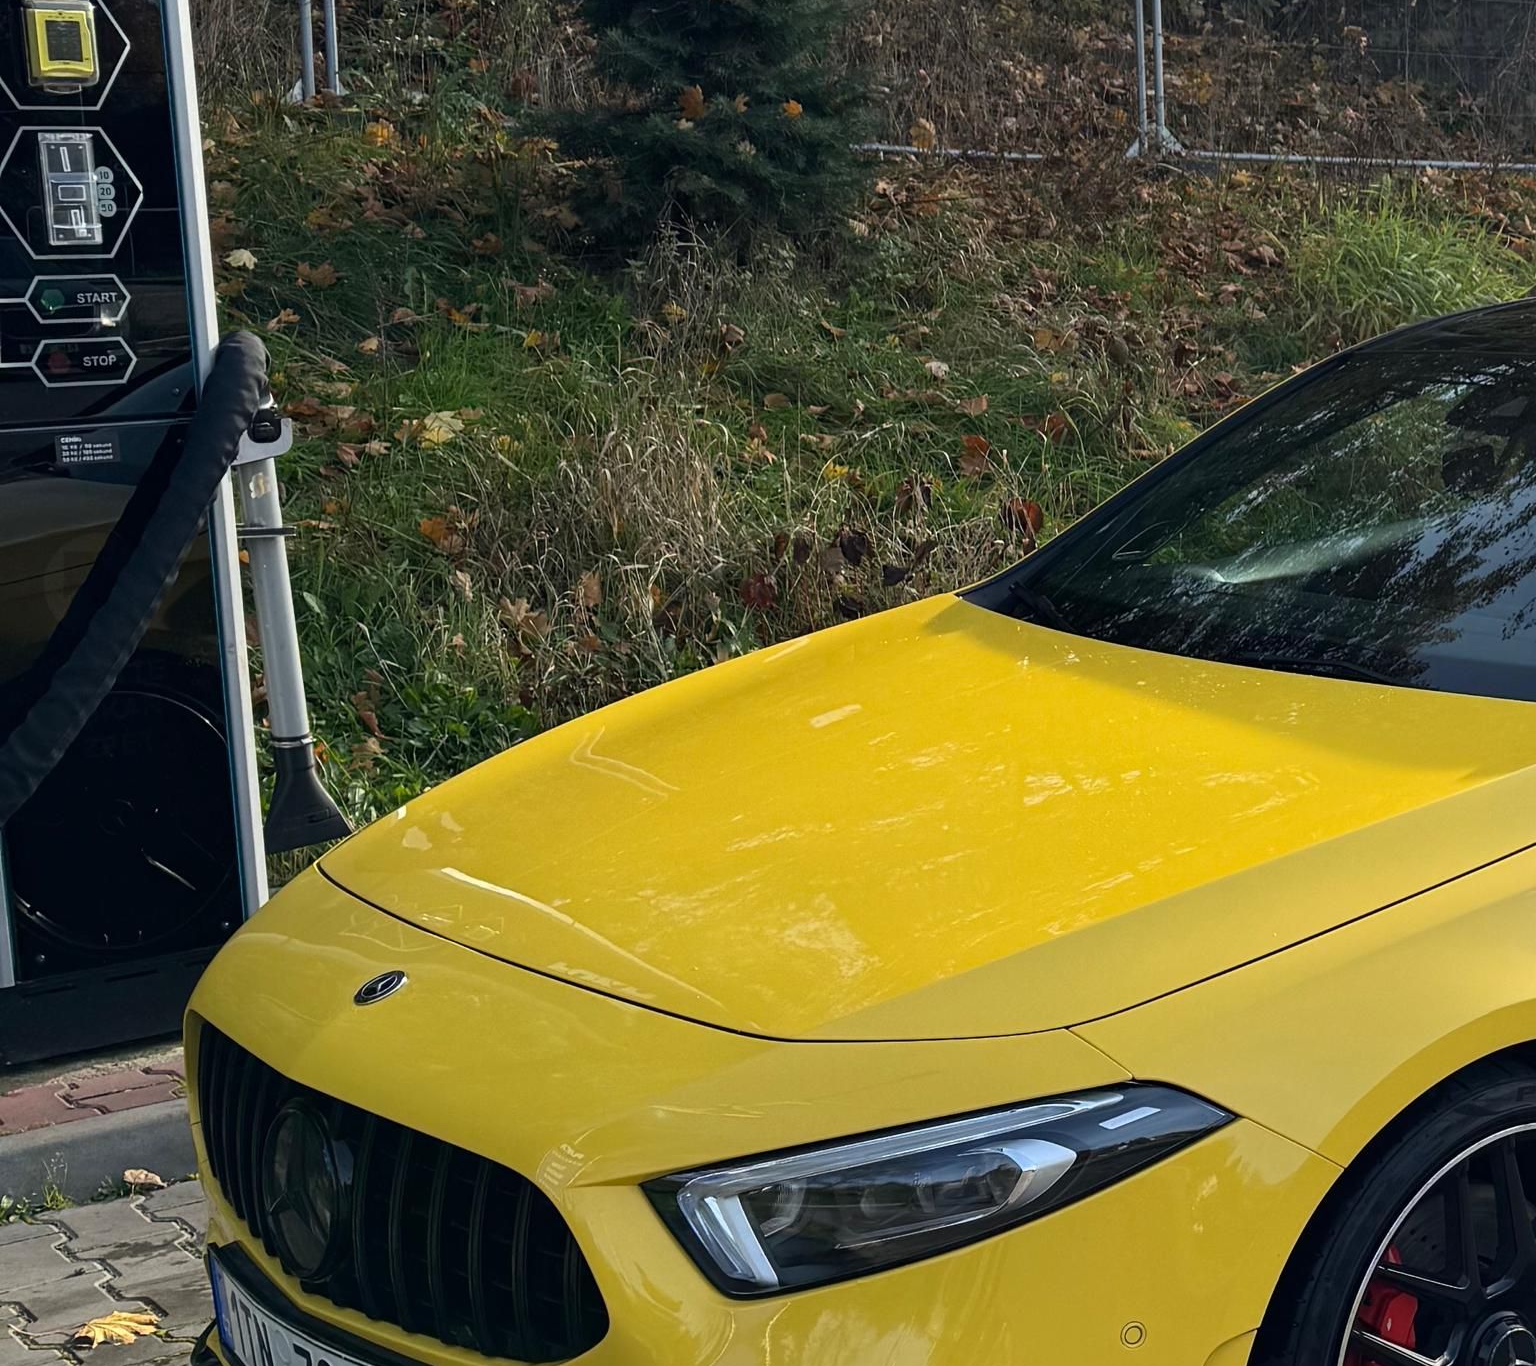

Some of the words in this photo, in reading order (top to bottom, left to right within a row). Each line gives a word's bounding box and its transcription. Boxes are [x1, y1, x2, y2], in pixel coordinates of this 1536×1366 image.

[99, 171, 110, 179] 10
[100, 187, 111, 196] 20
[101, 203, 113, 212] 50
[76, 292, 118, 304] START
[83, 354, 117, 367] STOP
